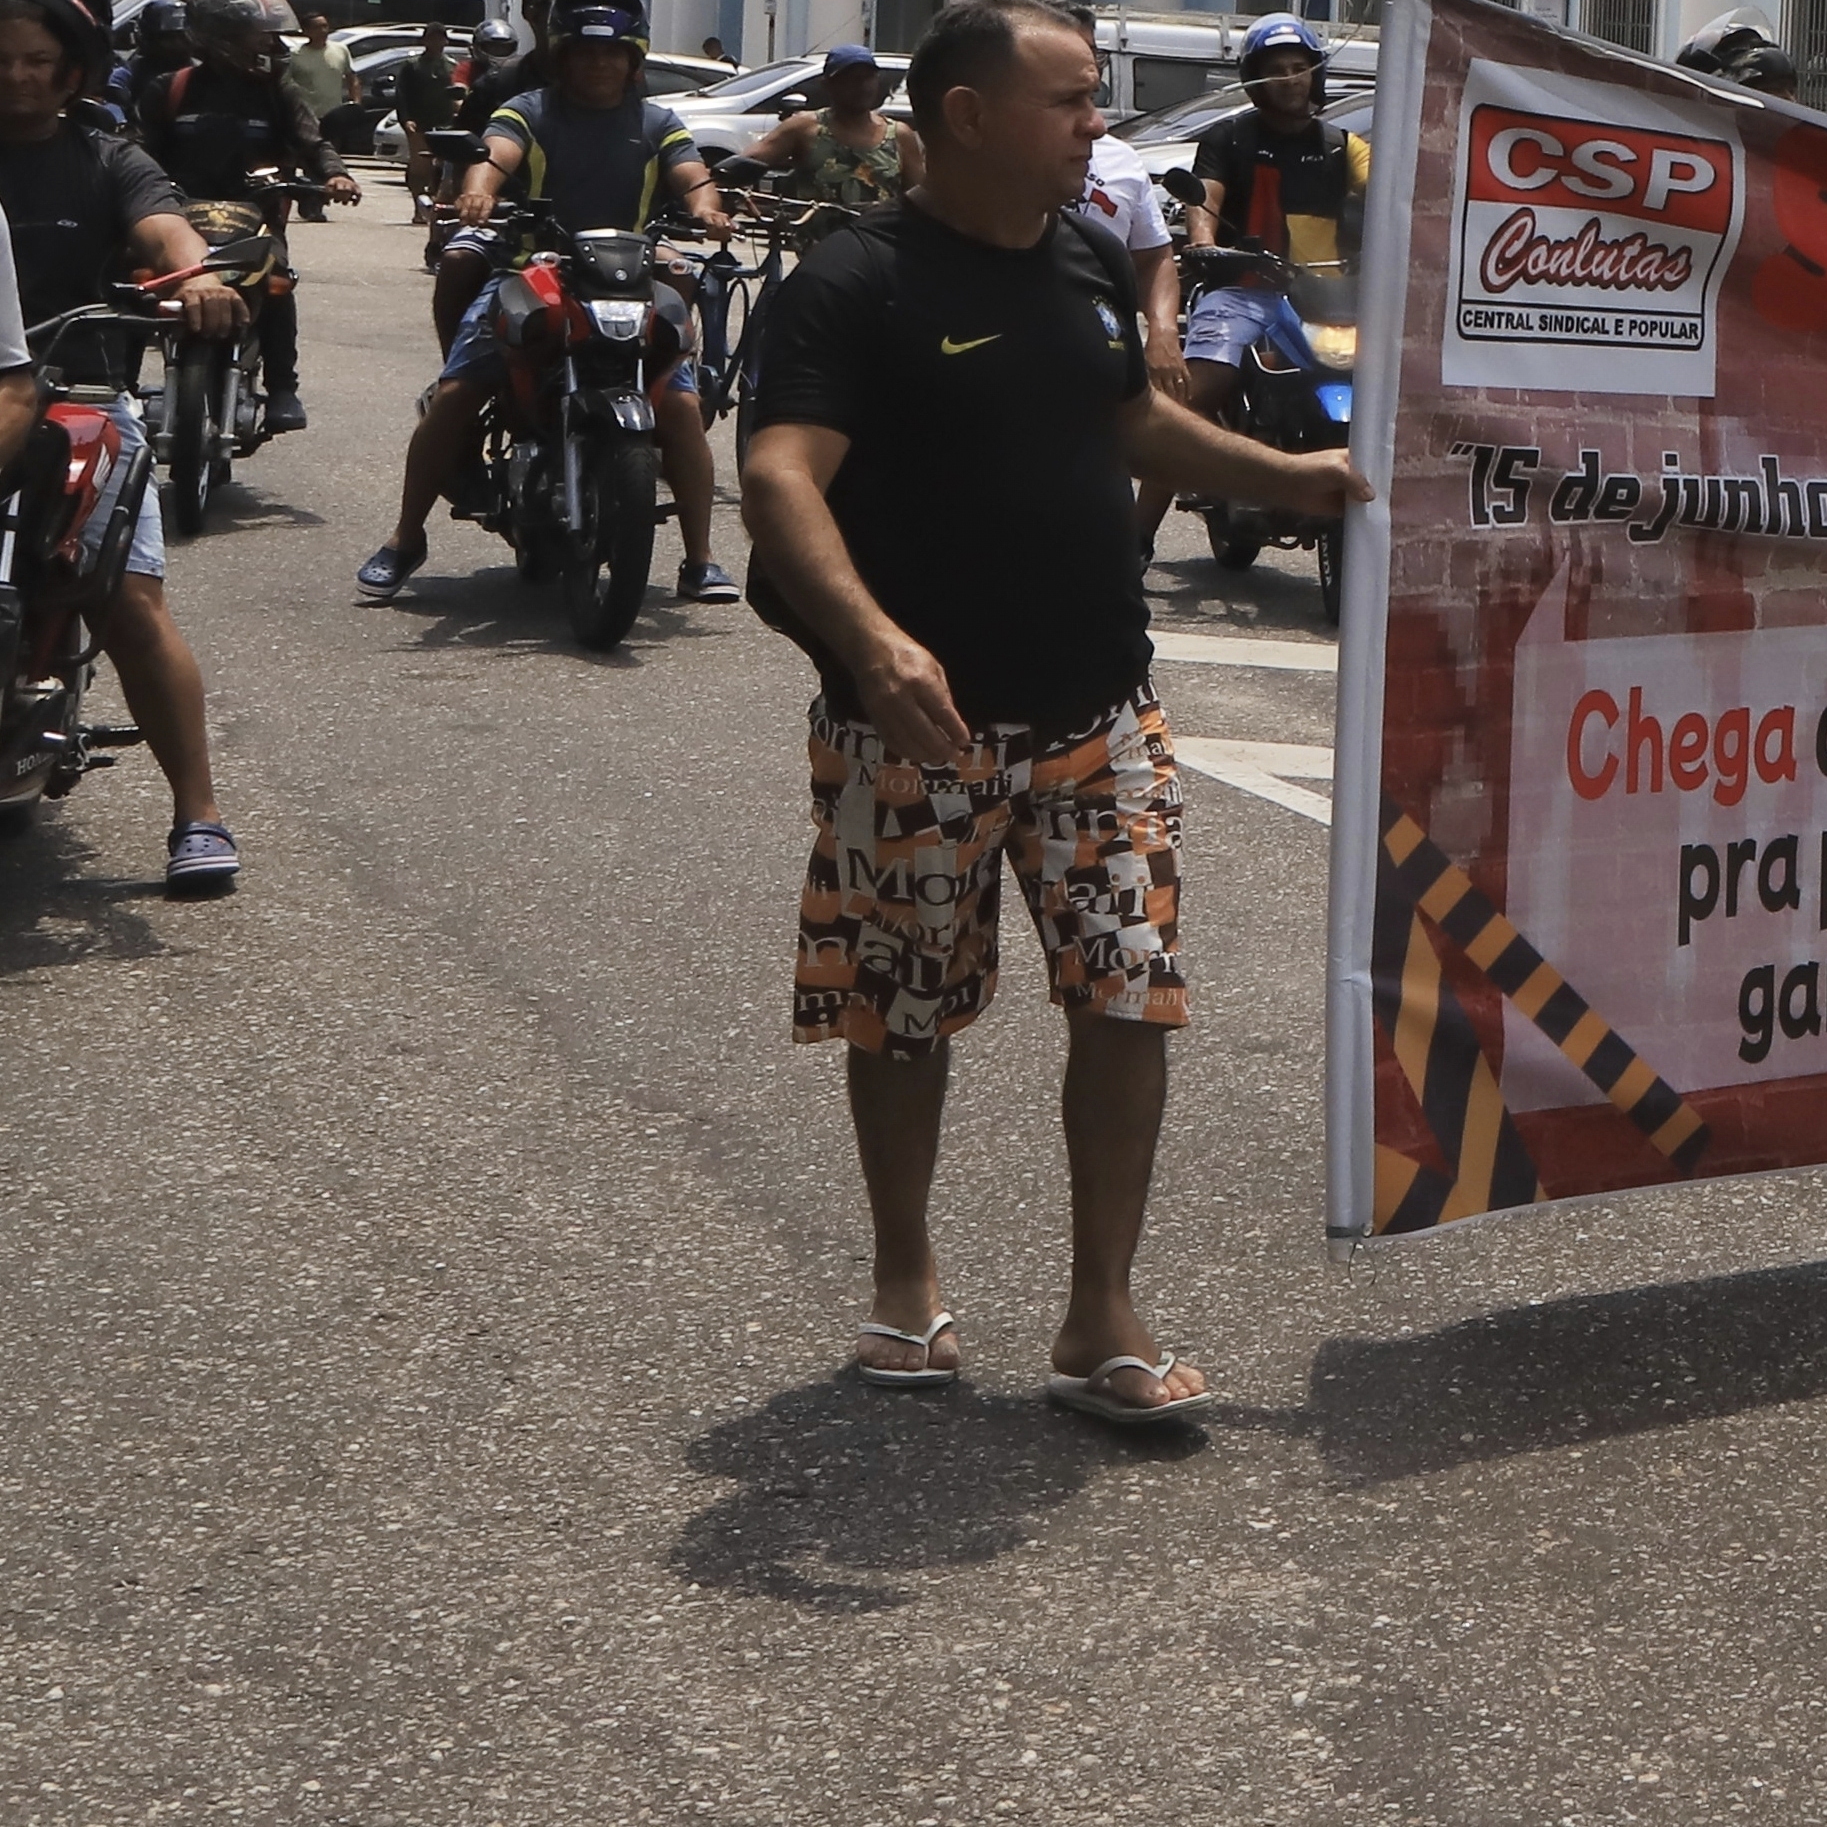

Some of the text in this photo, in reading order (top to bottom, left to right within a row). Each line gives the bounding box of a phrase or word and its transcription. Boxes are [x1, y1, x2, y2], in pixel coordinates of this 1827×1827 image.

[1487, 126, 1715, 211] CSP
[1479, 206, 1694, 294] Conlutas
[1461, 309, 1700, 341] CENTRAL SINDICAL E POPULAR
[1549, 450, 1641, 525] de
[1566, 686, 1796, 805] Chega
[1677, 832, 1802, 945] pra
